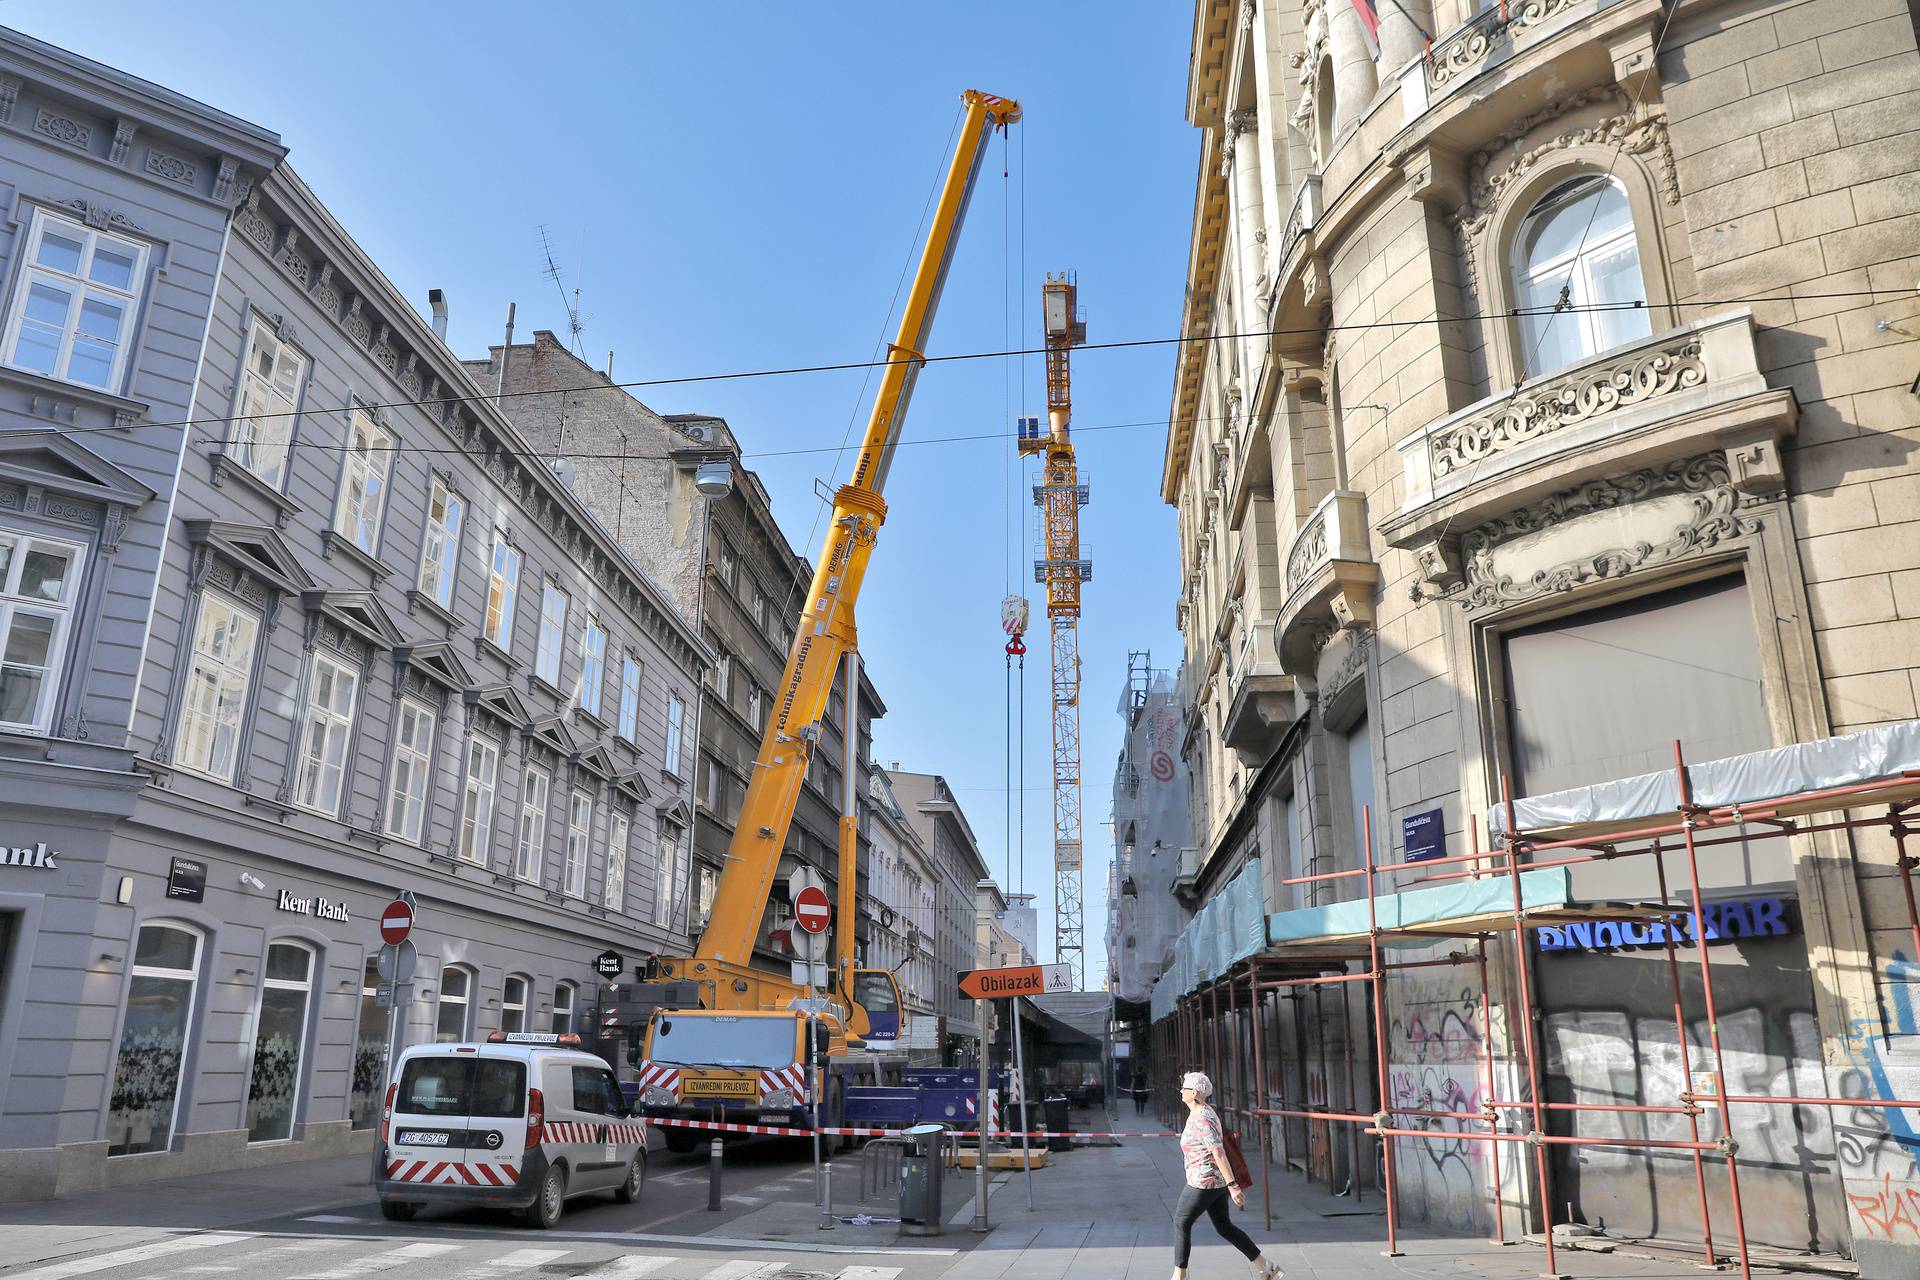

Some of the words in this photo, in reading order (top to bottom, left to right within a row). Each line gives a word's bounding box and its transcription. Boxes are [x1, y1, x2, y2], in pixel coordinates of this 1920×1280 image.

[854, 452, 871, 487] adnja
[828, 542, 843, 573] DEMAG
[776, 635, 812, 730] tehnikagradnja
[278, 889, 311, 914] Kent
[315, 897, 350, 922] Bank
[1538, 912, 1685, 951] SNACK
[1689, 899, 1790, 941] BAR
[599, 964, 620, 972] Bank
[600, 957, 618, 965] Kent
[981, 972, 1040, 992] Obilazak
[690, 1081, 722, 1091] IZVANREDNI
[723, 1082, 750, 1092] PRIJEVOZ
[405, 1132, 415, 1143] ZG
